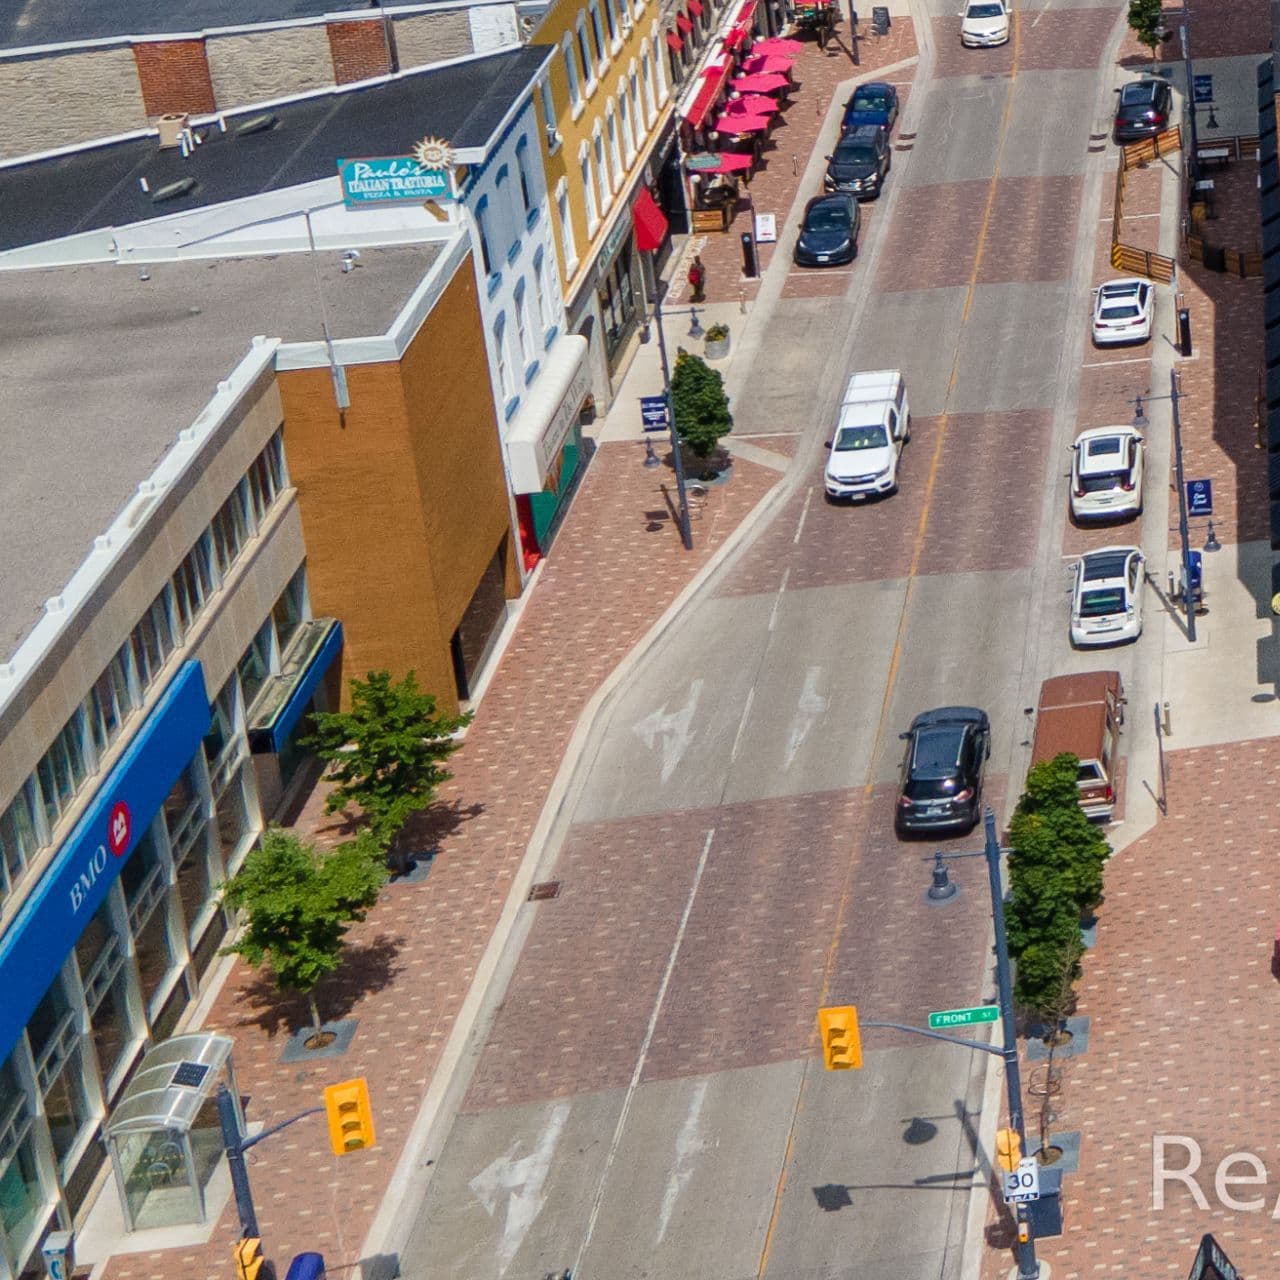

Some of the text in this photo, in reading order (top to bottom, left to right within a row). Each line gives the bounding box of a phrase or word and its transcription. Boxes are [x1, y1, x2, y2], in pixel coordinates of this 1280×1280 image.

[353, 161, 427, 182] Paulo's
[348, 175, 446, 193] ITALIAN TRATTORIA
[362, 191, 391, 199] PIZZA
[403, 188, 433, 196] PASTA
[70, 844, 107, 914] BMO
[936, 1012, 971, 1024] FRONT
[1008, 1173, 1034, 1190] 30
